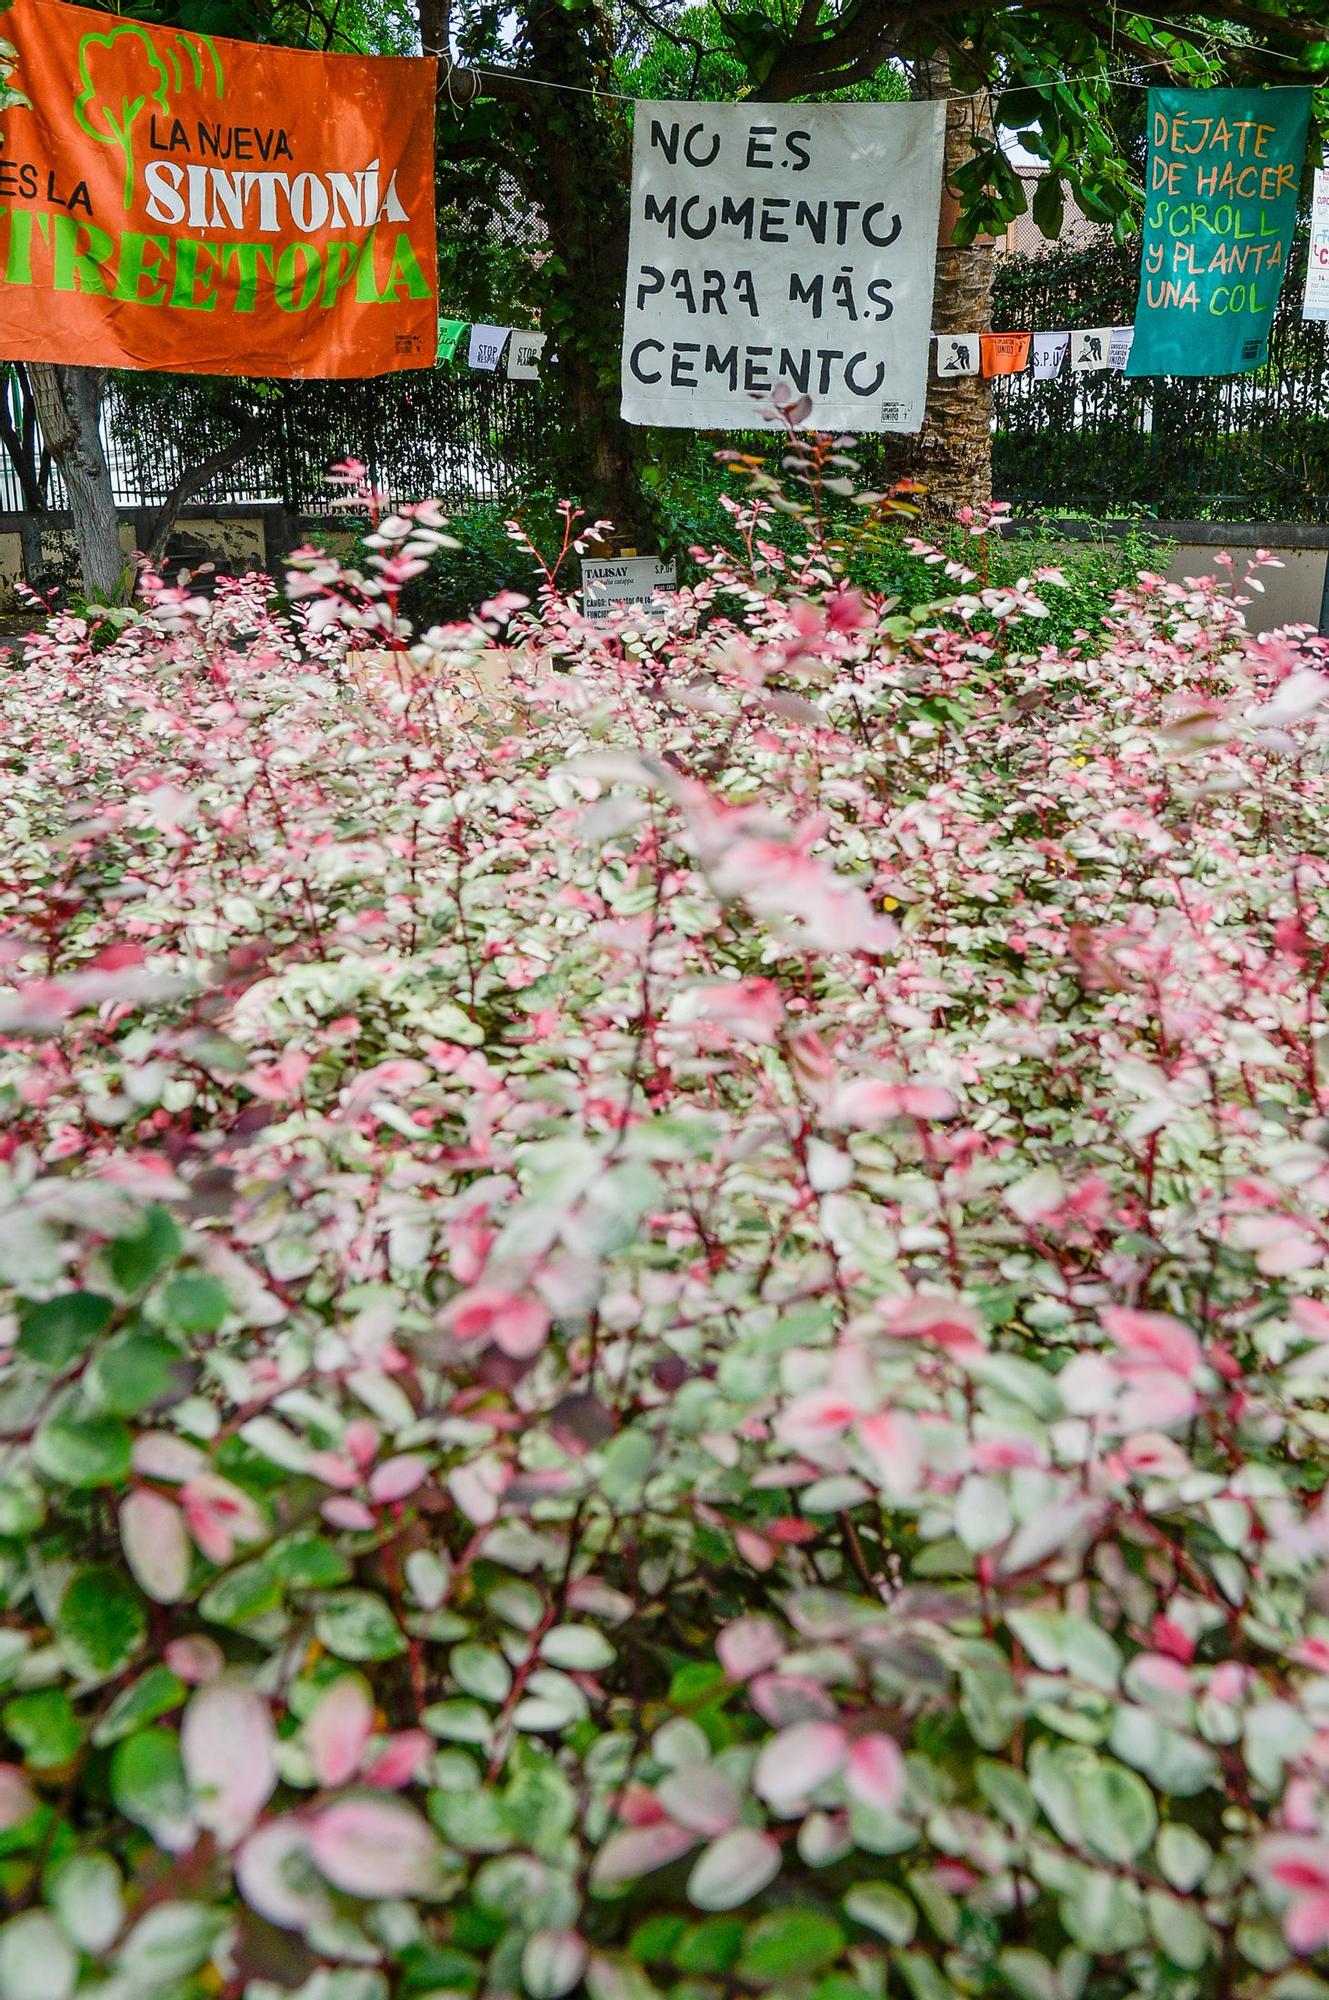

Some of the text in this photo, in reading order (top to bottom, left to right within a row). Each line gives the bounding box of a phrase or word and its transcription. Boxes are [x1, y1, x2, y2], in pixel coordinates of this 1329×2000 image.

[150, 114, 293, 161] LA NUEVA
[651, 120, 720, 167] NO
[1154, 111, 1276, 158] DÉJATE
[0, 160, 93, 216] ES LA
[145, 158, 410, 233] SINTONÍA
[1152, 156, 1297, 200] DE HACER
[644, 194, 902, 247] MOMENTO
[1149, 201, 1280, 239] SCROLL
[1173, 240, 1282, 275] PLANTA
[637, 265, 759, 317] PARA
[1146, 280, 1267, 316] UNA COL
[478, 344, 498, 357] STOP
[517, 347, 538, 360] STOP
[629, 338, 885, 397] CEMENTO
[585, 567, 628, 578] TALISAY
